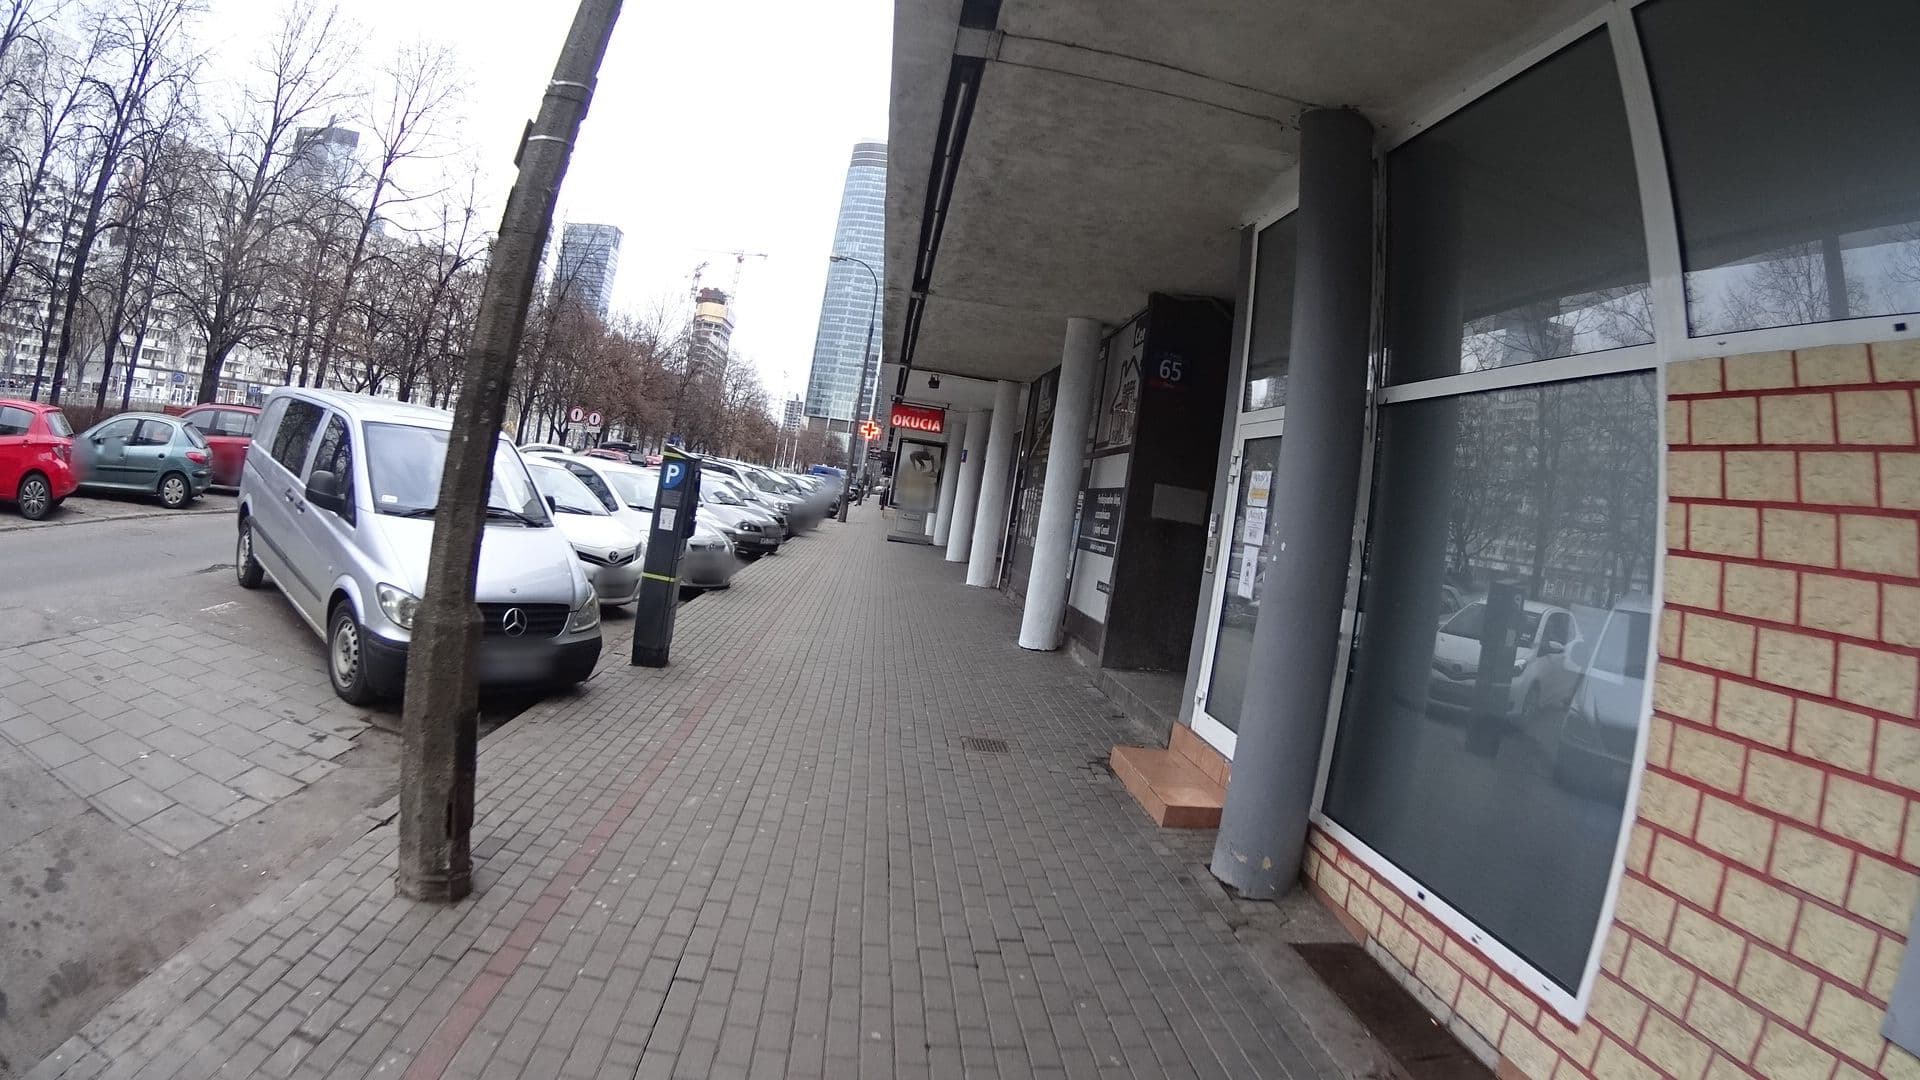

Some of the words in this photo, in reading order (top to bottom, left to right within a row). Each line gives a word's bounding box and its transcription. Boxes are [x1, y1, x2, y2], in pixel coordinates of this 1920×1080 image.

[1160, 359, 1182, 381] 65
[892, 414, 941, 431] OKUCIA
[665, 463, 680, 484] P
